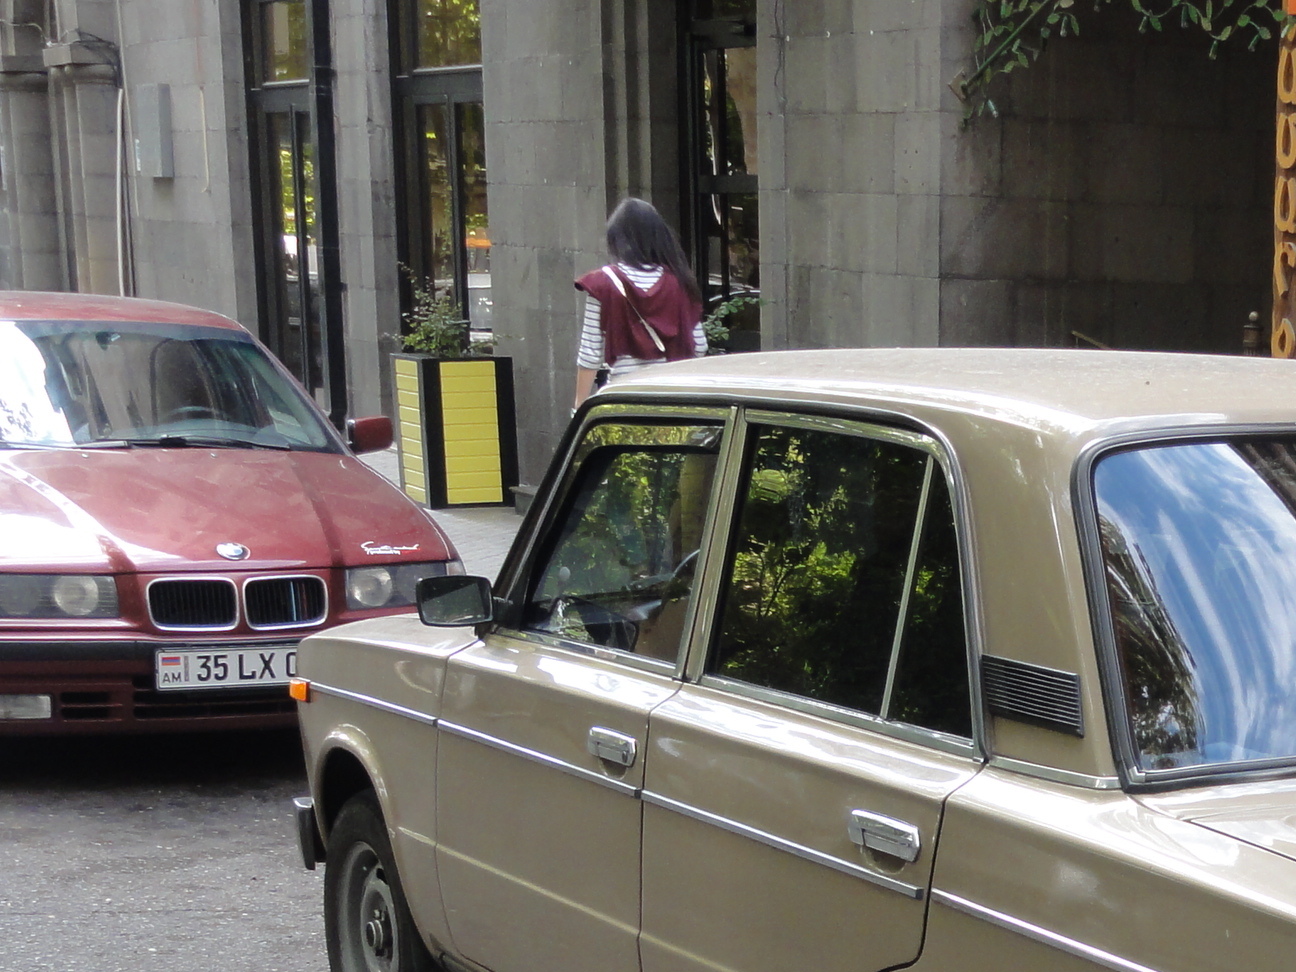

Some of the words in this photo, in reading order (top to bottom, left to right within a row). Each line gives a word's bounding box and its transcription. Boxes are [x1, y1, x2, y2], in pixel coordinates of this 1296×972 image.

[196, 654, 228, 682] 35
[238, 652, 276, 680] LX
[162, 672, 181, 683] AM
